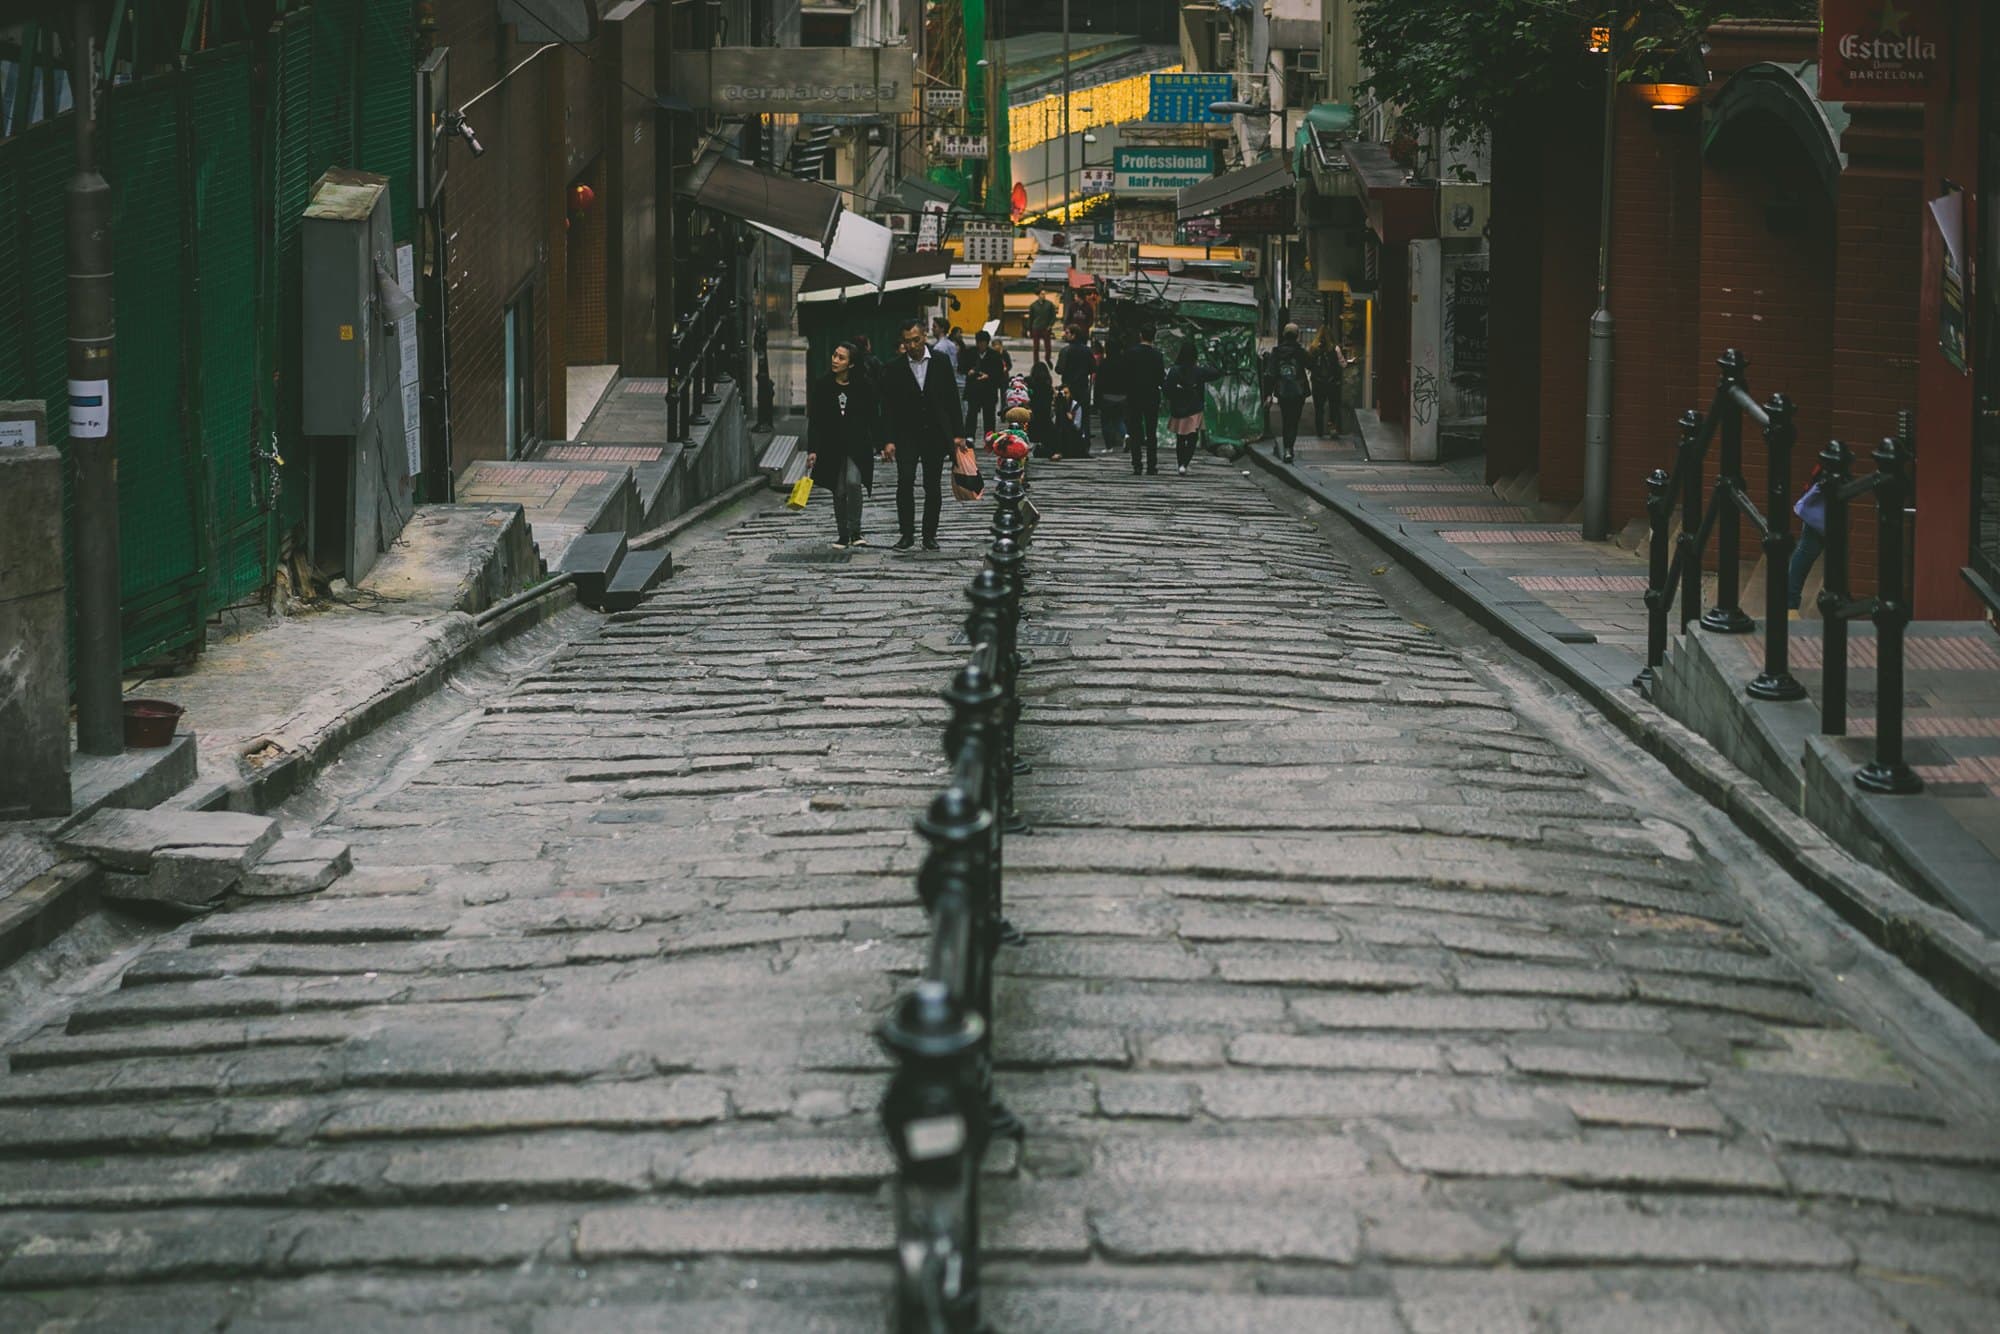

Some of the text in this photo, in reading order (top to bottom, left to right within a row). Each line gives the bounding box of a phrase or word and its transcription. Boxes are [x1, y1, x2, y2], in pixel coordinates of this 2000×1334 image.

[1838, 33, 1937, 60] Estrella
[1849, 70, 1925, 80] BARCELONA
[723, 81, 896, 103] dermalogica
[1121, 154, 1207, 169] Professional
[1128, 176, 1150, 188] Hair
